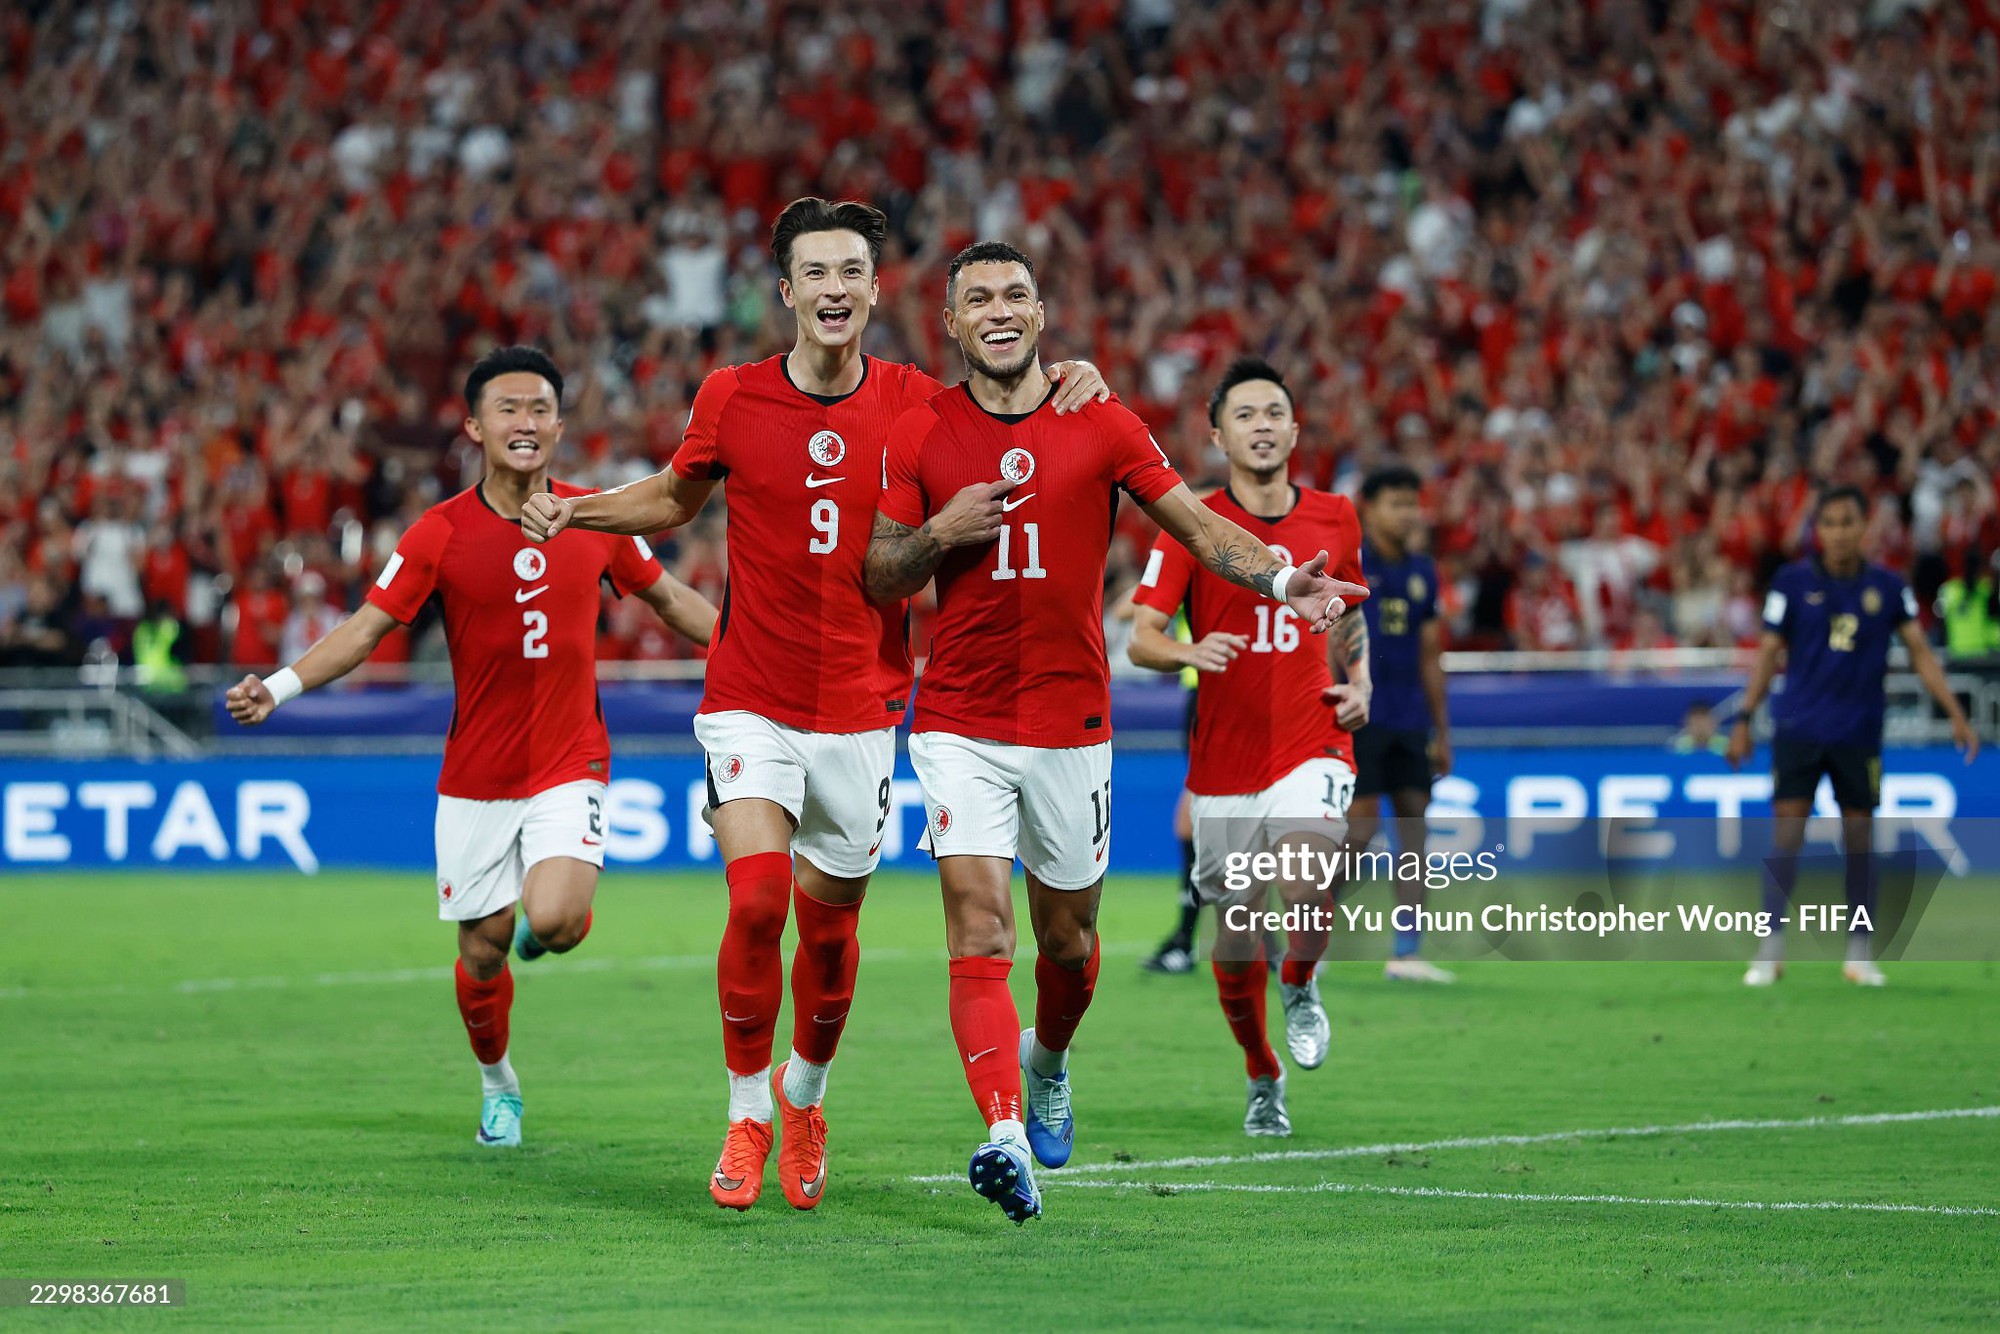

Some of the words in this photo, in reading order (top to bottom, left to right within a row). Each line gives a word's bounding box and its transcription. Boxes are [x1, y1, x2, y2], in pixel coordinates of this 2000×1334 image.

[809, 498, 839, 554] 9
[991, 523, 1047, 580] 11
[523, 610, 549, 659] 2
[1251, 605, 1300, 653] 16
[1829, 613, 1859, 651] 12
[3, 780, 320, 876] ETAR
[588, 796, 602, 836] 2
[877, 776, 890, 834] 9
